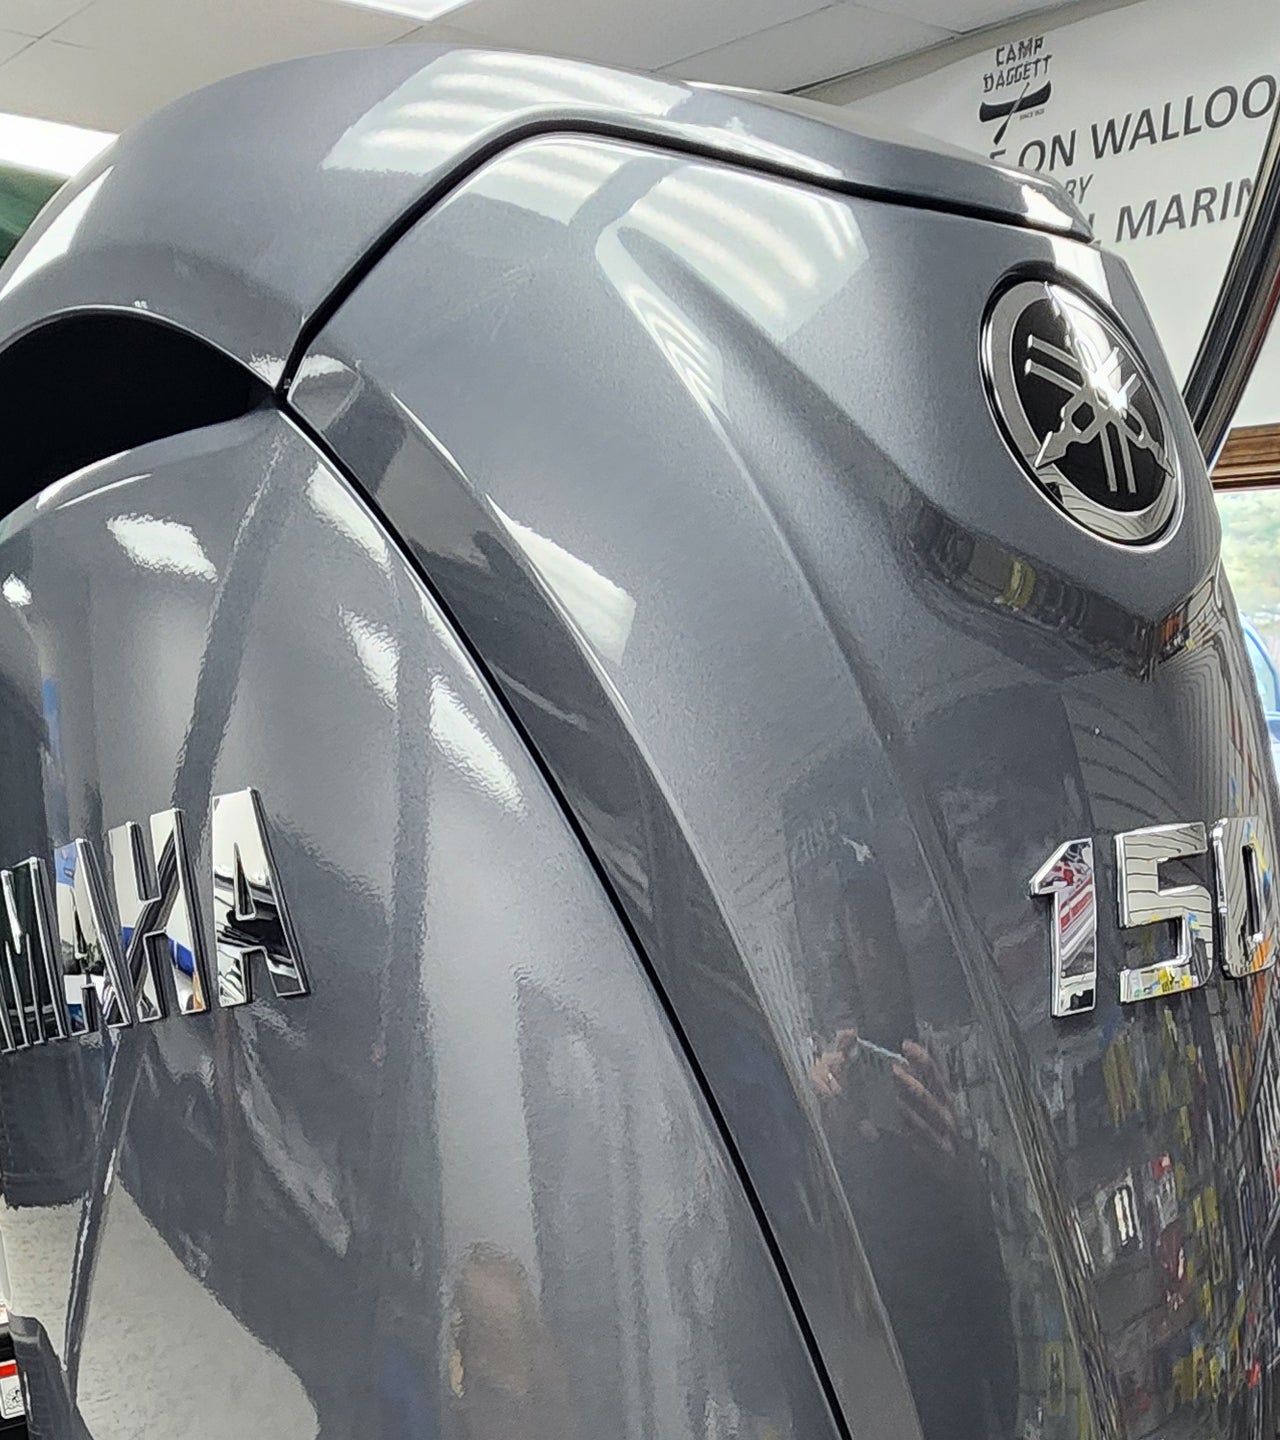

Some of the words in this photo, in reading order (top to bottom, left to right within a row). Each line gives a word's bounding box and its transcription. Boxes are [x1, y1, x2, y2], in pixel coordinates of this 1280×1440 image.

[983, 54, 1053, 93] DAGGETT
[996, 36, 1044, 66] CAMP
[1018, 129, 1077, 172] ON
[1091, 75, 1277, 160] WALLOO
[1116, 177, 1253, 243] MARIN
[1027, 816, 1277, 1019] 150
